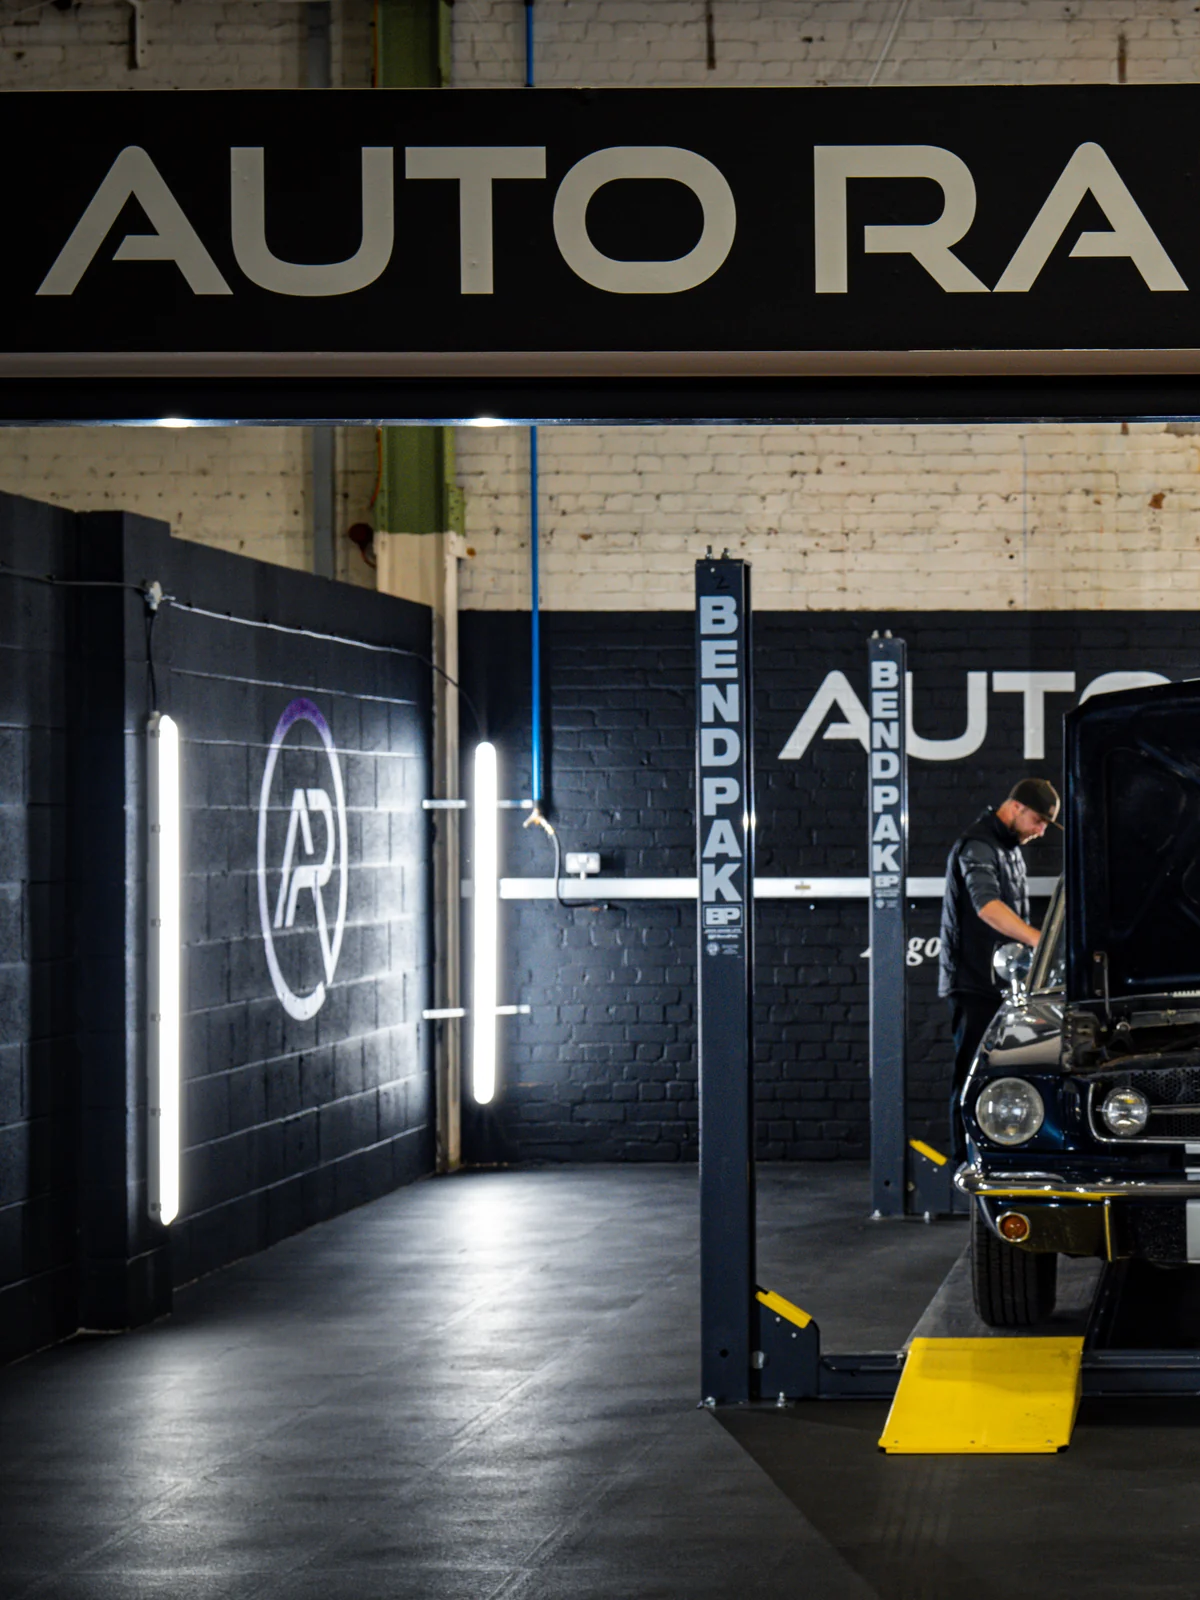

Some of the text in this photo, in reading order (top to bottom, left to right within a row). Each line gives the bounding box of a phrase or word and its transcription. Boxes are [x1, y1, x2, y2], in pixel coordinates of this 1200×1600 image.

[35, 145, 736, 297] AUTO
[699, 595, 742, 902] BENDPAK
[778, 669, 1172, 761] AUT
[870, 660, 901, 872] BENDPAK
[706, 907, 741, 925] BP
